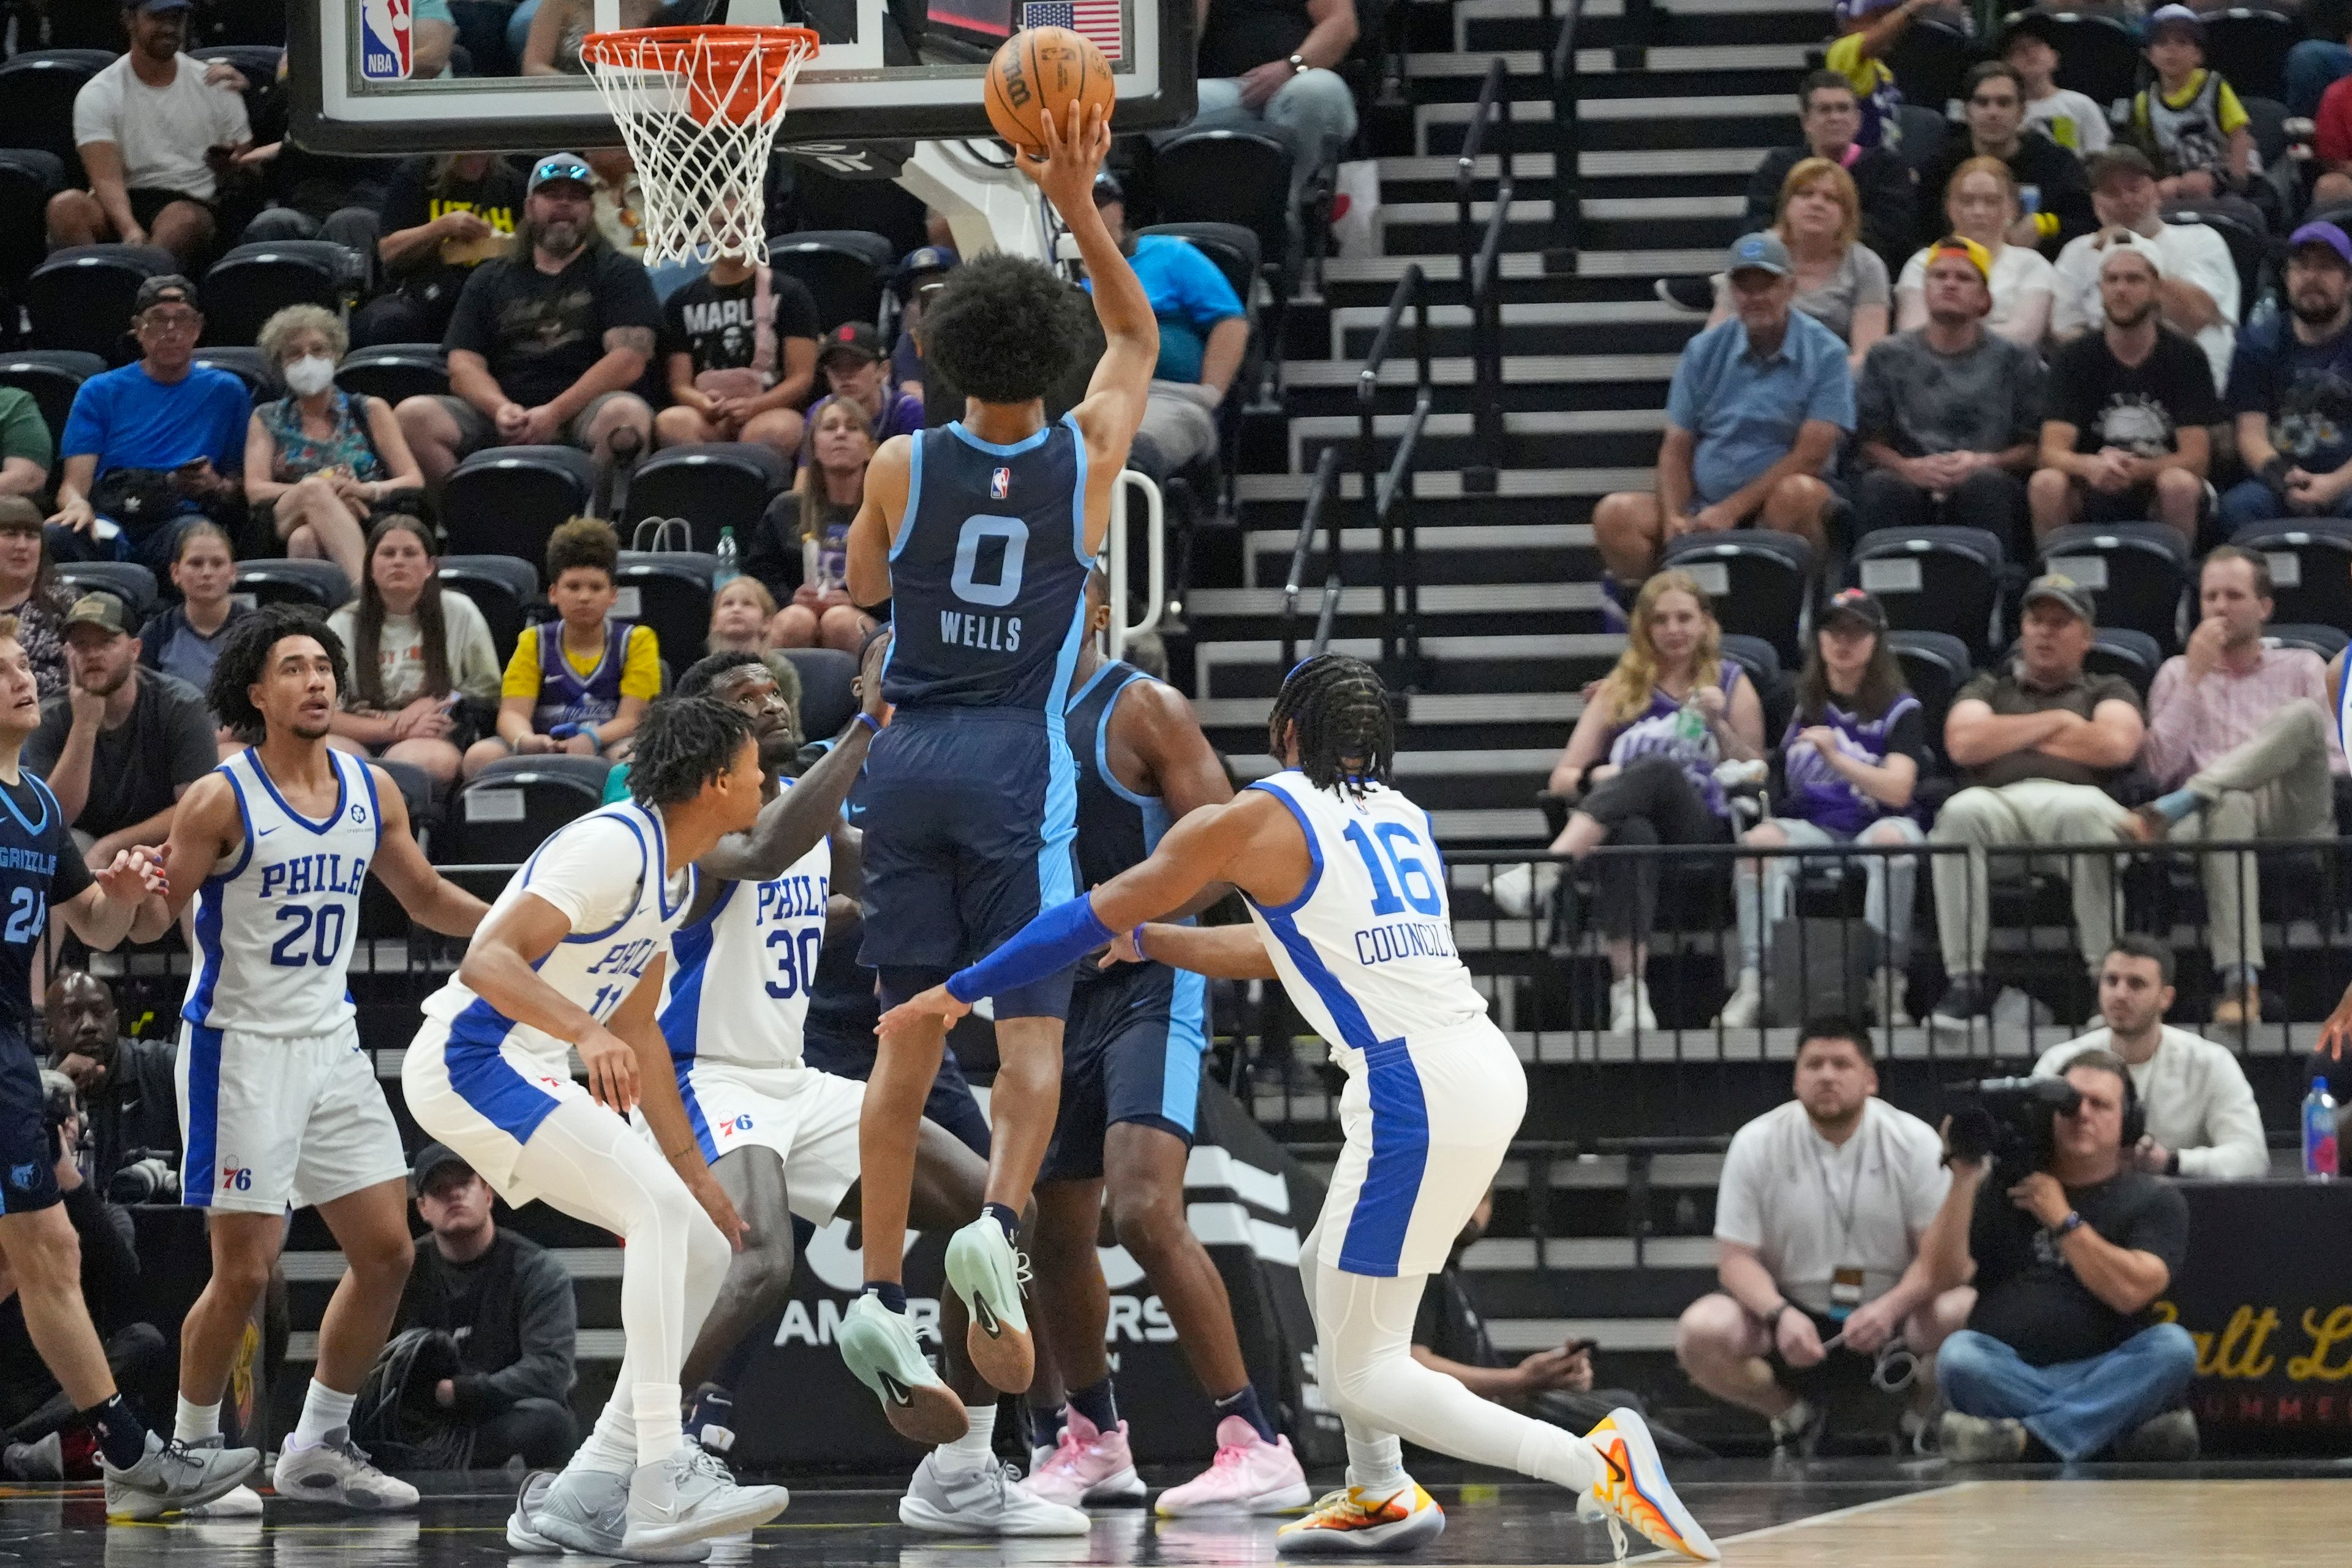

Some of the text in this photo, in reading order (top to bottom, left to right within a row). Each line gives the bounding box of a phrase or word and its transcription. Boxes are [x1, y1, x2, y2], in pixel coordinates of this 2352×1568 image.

[368, 53, 393, 73] NBA
[951, 514, 1030, 606] 0
[941, 610, 1022, 652] WELLS
[258, 853, 366, 899] PHILA
[1342, 818, 1441, 917] 16
[270, 903, 345, 967] 20
[1354, 922, 1448, 965] COUNCIL
[765, 927, 821, 999] 30
[719, 1114, 753, 1137] 76
[222, 1166, 251, 1191] 76
